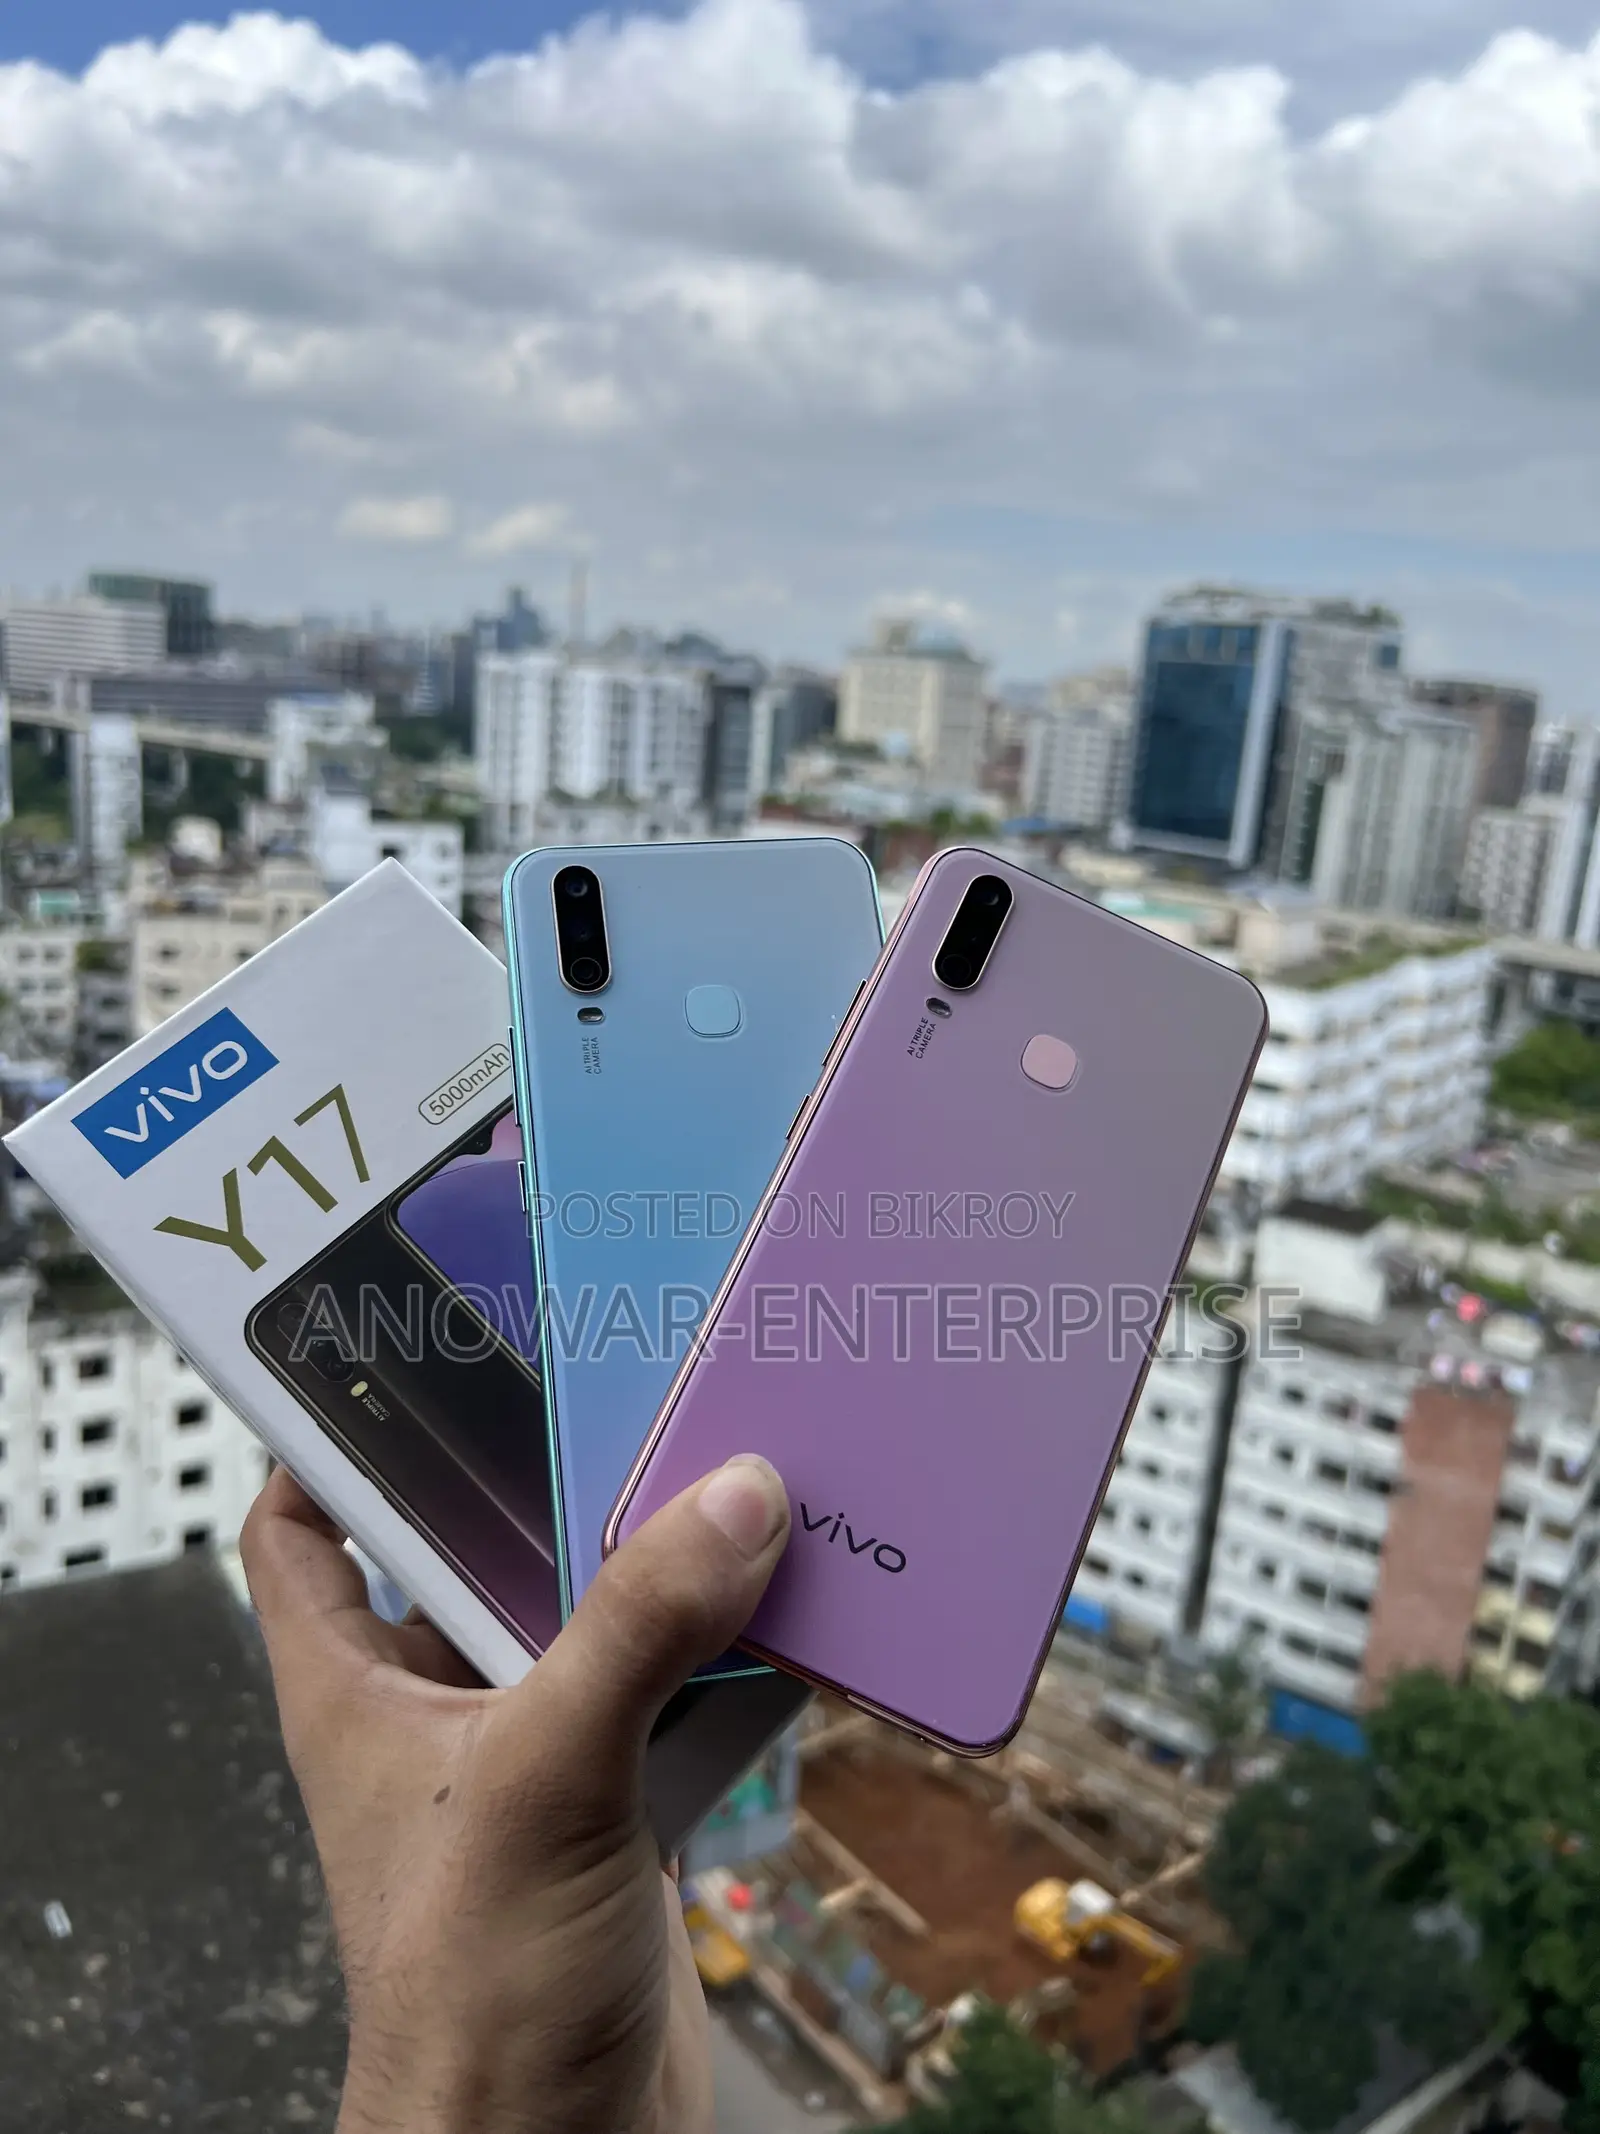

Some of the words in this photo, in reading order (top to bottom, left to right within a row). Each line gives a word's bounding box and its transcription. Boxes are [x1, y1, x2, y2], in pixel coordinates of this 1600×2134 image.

[581, 1036, 591, 1064] TRIPLE
[590, 1036, 602, 1075] CAMERA
[911, 1016, 929, 1045] TRIPLE
[915, 1023, 937, 1059] CAMERA
[104, 1040, 248, 1143] vivo
[428, 1051, 510, 1116] 5000mAh
[153, 1083, 371, 1272] Y17
[800, 1501, 906, 1573] vivo
